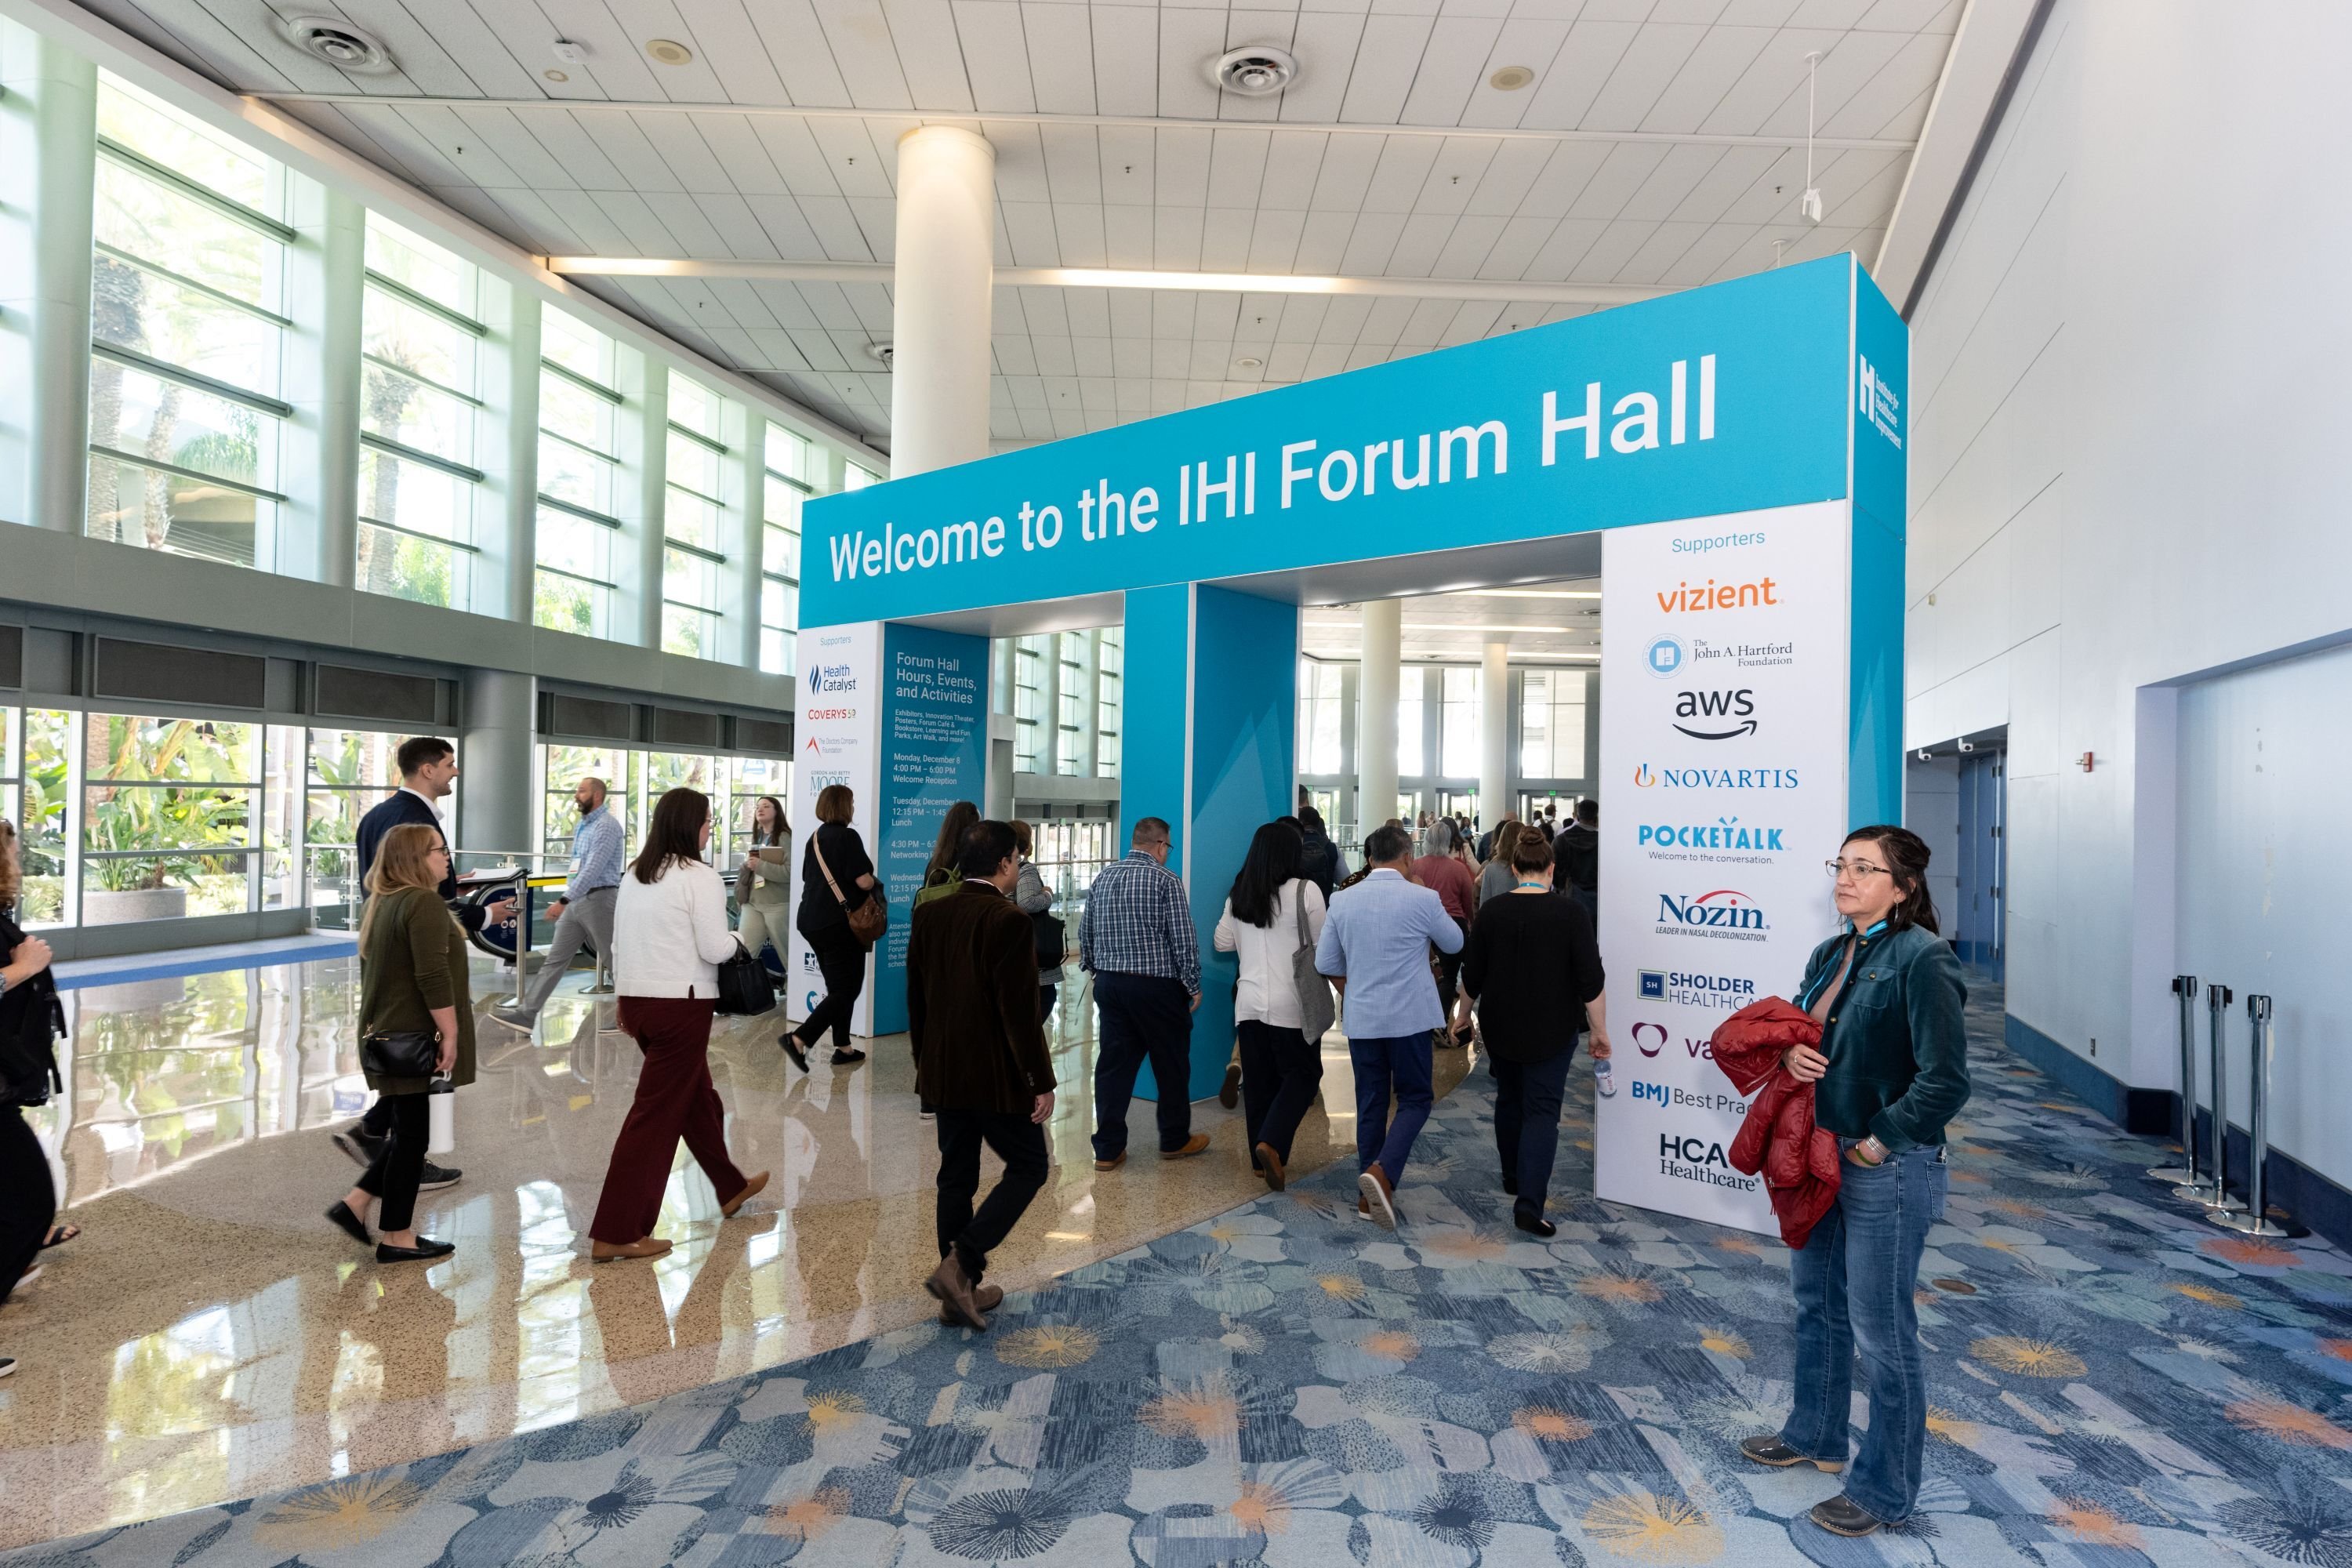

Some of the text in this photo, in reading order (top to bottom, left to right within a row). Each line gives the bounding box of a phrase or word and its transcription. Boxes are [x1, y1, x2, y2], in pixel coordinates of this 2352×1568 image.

[829, 354, 1715, 582] Welcome to the IHI Forum Hall
[1671, 532, 1765, 554] Supporters
[1657, 577, 1777, 613] vizient
[820, 636, 851, 646] Supporters
[1694, 642, 1792, 662] John A. Hartford
[897, 652, 959, 671] Forum Hall
[1738, 657, 1792, 666] Foundation
[824, 664, 850, 677] Health
[823, 678, 856, 693] Catalyst
[896, 668, 977, 691] Hours, Events,
[895, 685, 973, 704] and Activities
[1675, 688, 1754, 717] aws
[808, 709, 847, 720] COVERYS
[895, 709, 975, 723] Exhibitors, Innovation Theater,
[895, 717, 918, 725] Posters,
[895, 724, 924, 733] Bookstore,
[925, 727, 949, 735] Learning
[894, 753, 921, 763] Monday,
[923, 755, 955, 764] December
[893, 775, 957, 786] Welcome Reception
[1663, 769, 1798, 789] NOVARTIS
[892, 797, 921, 806] Tuesday,
[923, 797, 955, 806] December
[1639, 816, 1784, 851] POCKETALK
[891, 851, 928, 859] Networking
[1649, 851, 1687, 861] Welcome
[1700, 853, 1714, 862] the
[1716, 855, 1774, 864] conversation.
[890, 873, 924, 881] Wednesda
[889, 895, 909, 903] Lunch
[1657, 894, 1765, 930] Nozin
[1656, 926, 1682, 935] LEADER
[1688, 928, 1708, 938] NASAL
[1669, 972, 1755, 994] SHOLDER
[1685, 1038, 1715, 1060] va
[1632, 1080, 1669, 1108] BMJ
[1674, 1088, 1711, 1109] Best
[1661, 1133, 1729, 1169] HCA
[1660, 1159, 1758, 1192] Healthcare
